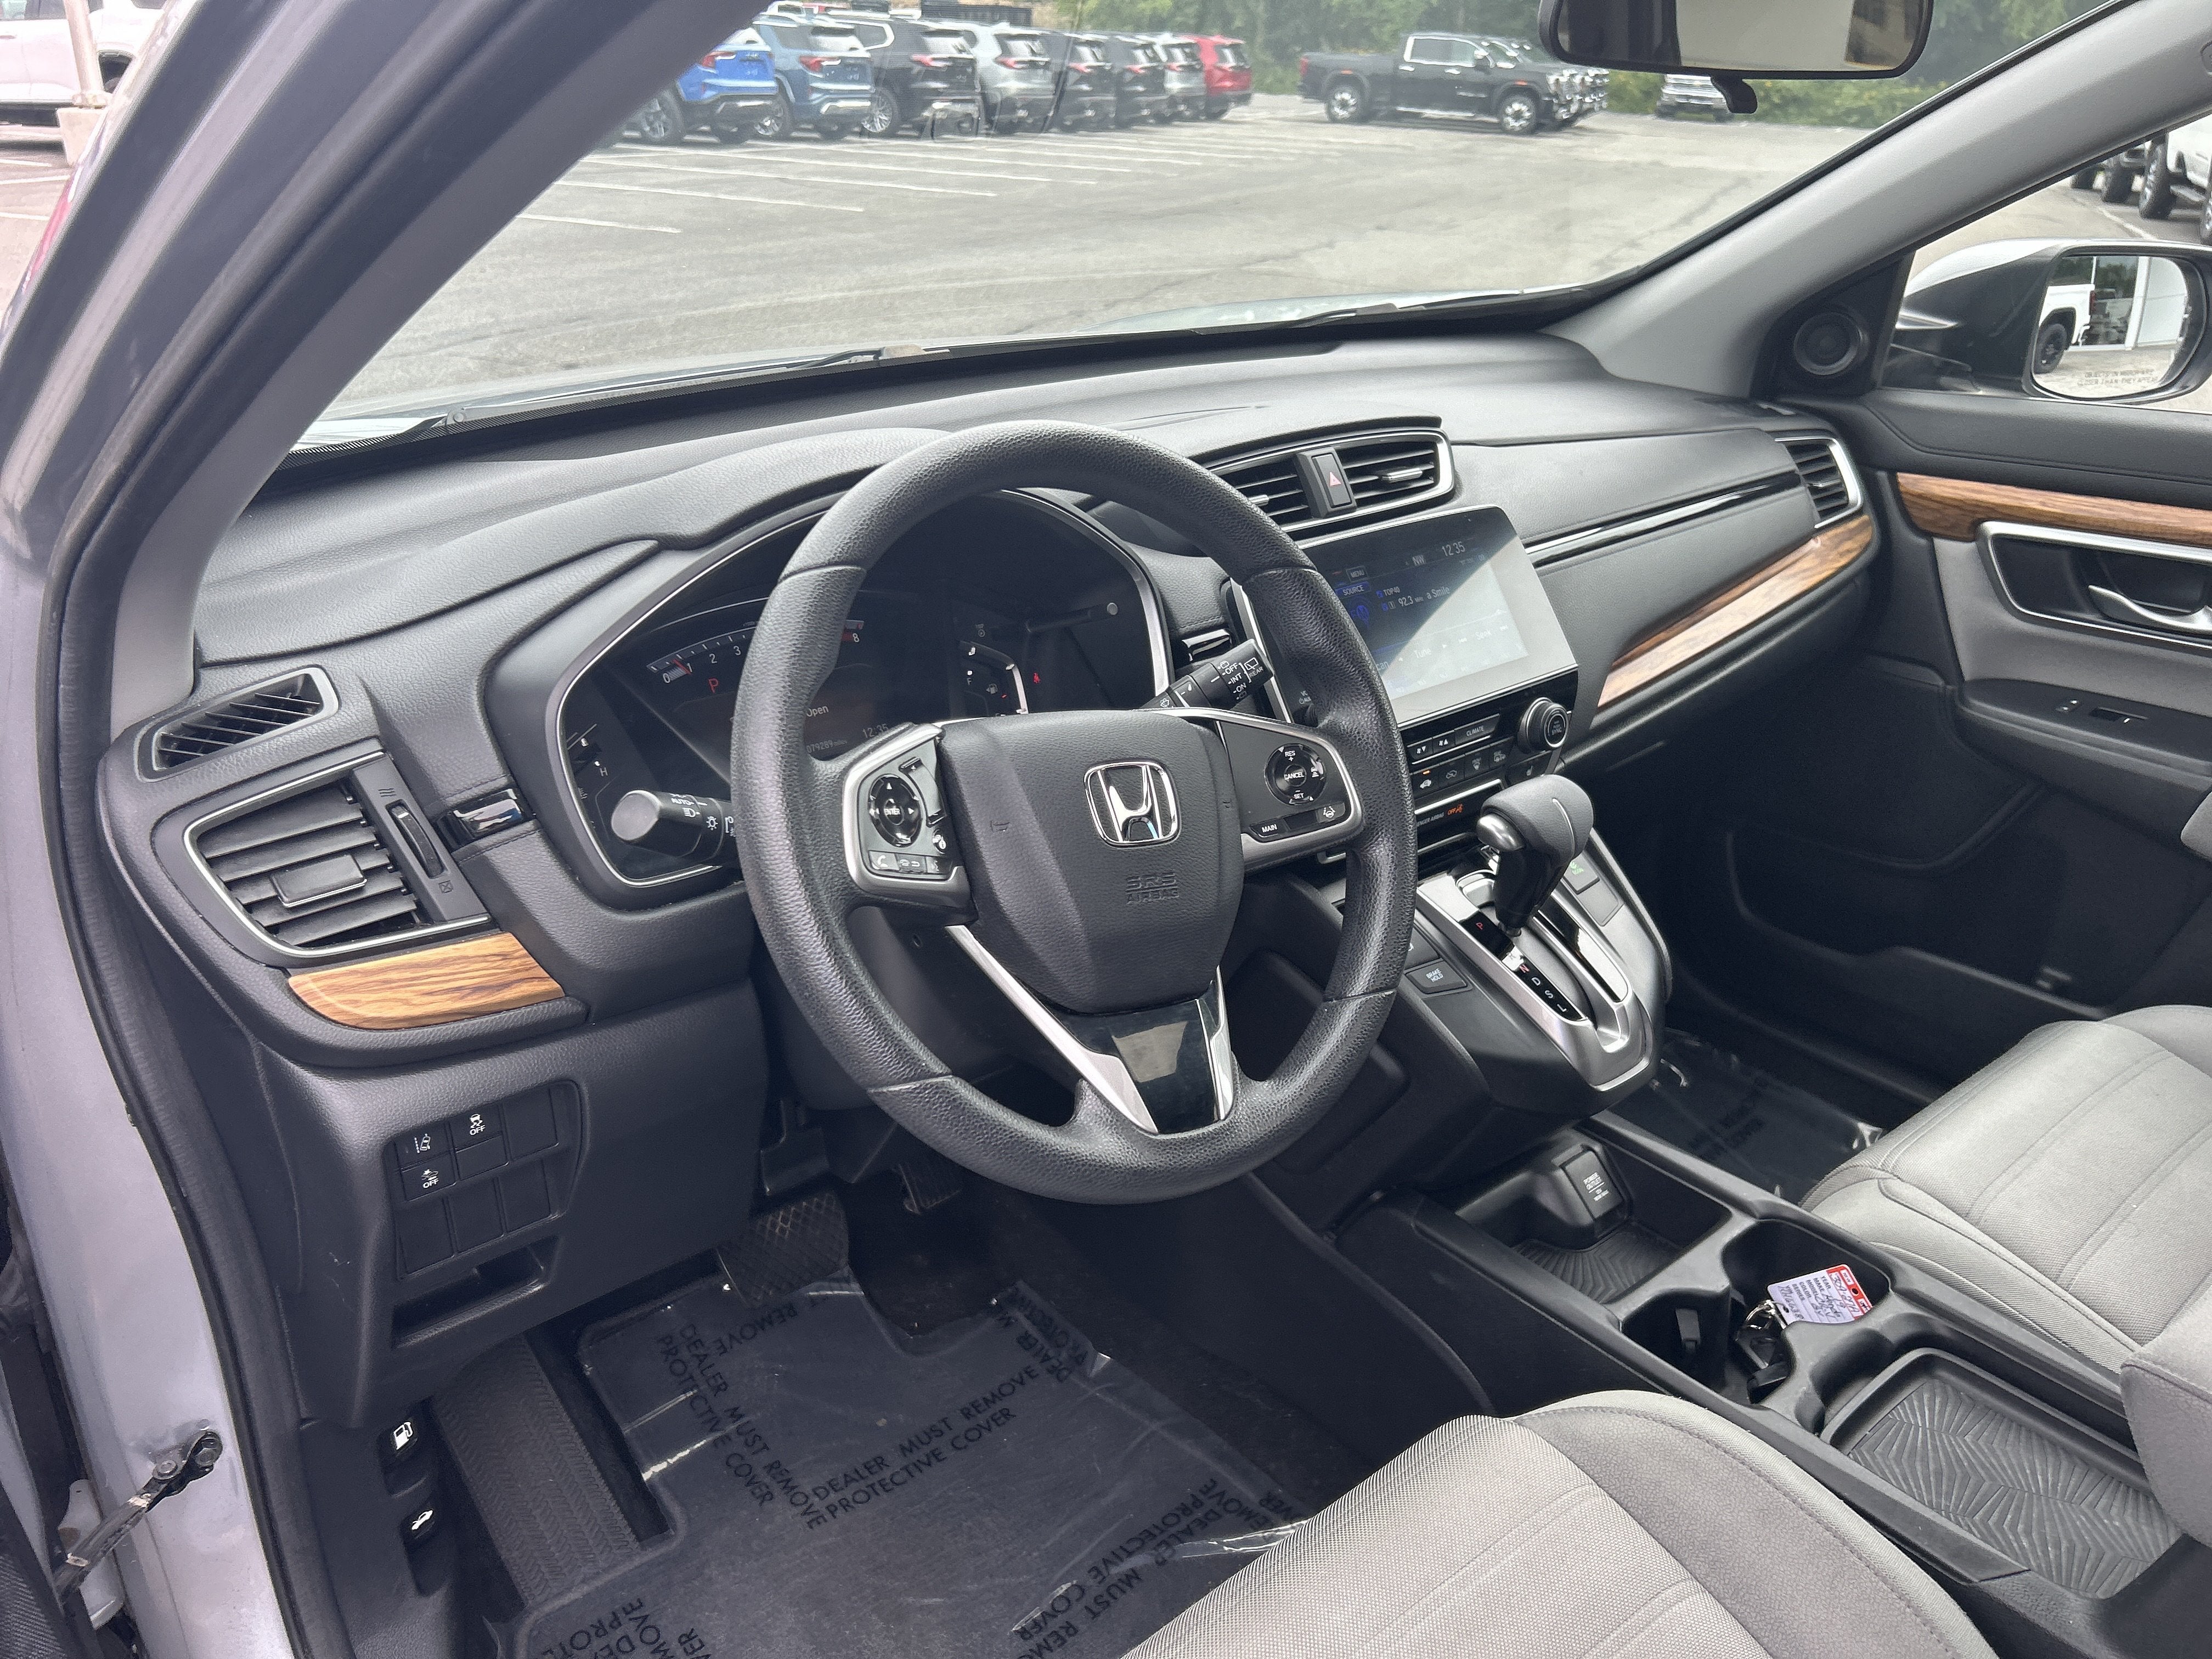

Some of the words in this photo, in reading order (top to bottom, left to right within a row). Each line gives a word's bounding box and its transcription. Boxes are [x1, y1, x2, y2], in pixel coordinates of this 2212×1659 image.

[1342, 585, 1365, 596] SOURCE
[1398, 596, 1414, 607] 92.3
[1432, 586, 1450, 598] Smile
[709, 653, 718, 664] 2
[733, 645, 741, 656] 3
[852, 633, 860, 642] 8
[1414, 648, 1432, 659] Tune
[1225, 662, 1238, 675] OFF
[1250, 667, 1263, 678] REAR
[708, 678, 719, 693] P
[1231, 673, 1243, 684] INT
[1236, 682, 1247, 692] ON
[806, 706, 829, 717] Open
[1466, 725, 1485, 737] CLIMATE
[1284, 772, 1305, 780] CANCEL
[1261, 824, 1278, 833] MAIN
[1126, 870, 1177, 891] SRS
[1426, 968, 1442, 979] BRAKE
[1430, 973, 1443, 983] HOLD
[1519, 964, 1530, 973] N
[1532, 977, 1541, 986] D
[1544, 990, 1554, 999] S
[1557, 1004, 1567, 1013] L
[469, 1125, 486, 1136] OFF
[422, 1178, 439, 1188] OFF
[1799, 1282, 1811, 1299] COLOR
[1805, 1279, 1818, 1296] MODEL
[1813, 1277, 1824, 1293] MAKE
[1820, 1276, 1831, 1290] YEAR
[715, 1302, 798, 1357] REMOVE
[680, 1323, 729, 1397] DEALER
[724, 1406, 770, 1455] MUST
[762, 1459, 827, 1530] REMOVE
[811, 1455, 890, 1500] DEALER
[899, 1417, 953, 1458] MUST
[960, 1365, 1040, 1420] REMOVE
[824, 1447, 947, 1519] PROTECTIVE
[951, 1407, 1017, 1452] COVER
[725, 1452, 774, 1507] COVER
[1087, 1493, 1205, 1585] PROTECTIVE
[1084, 1567, 1143, 1620] MUST
